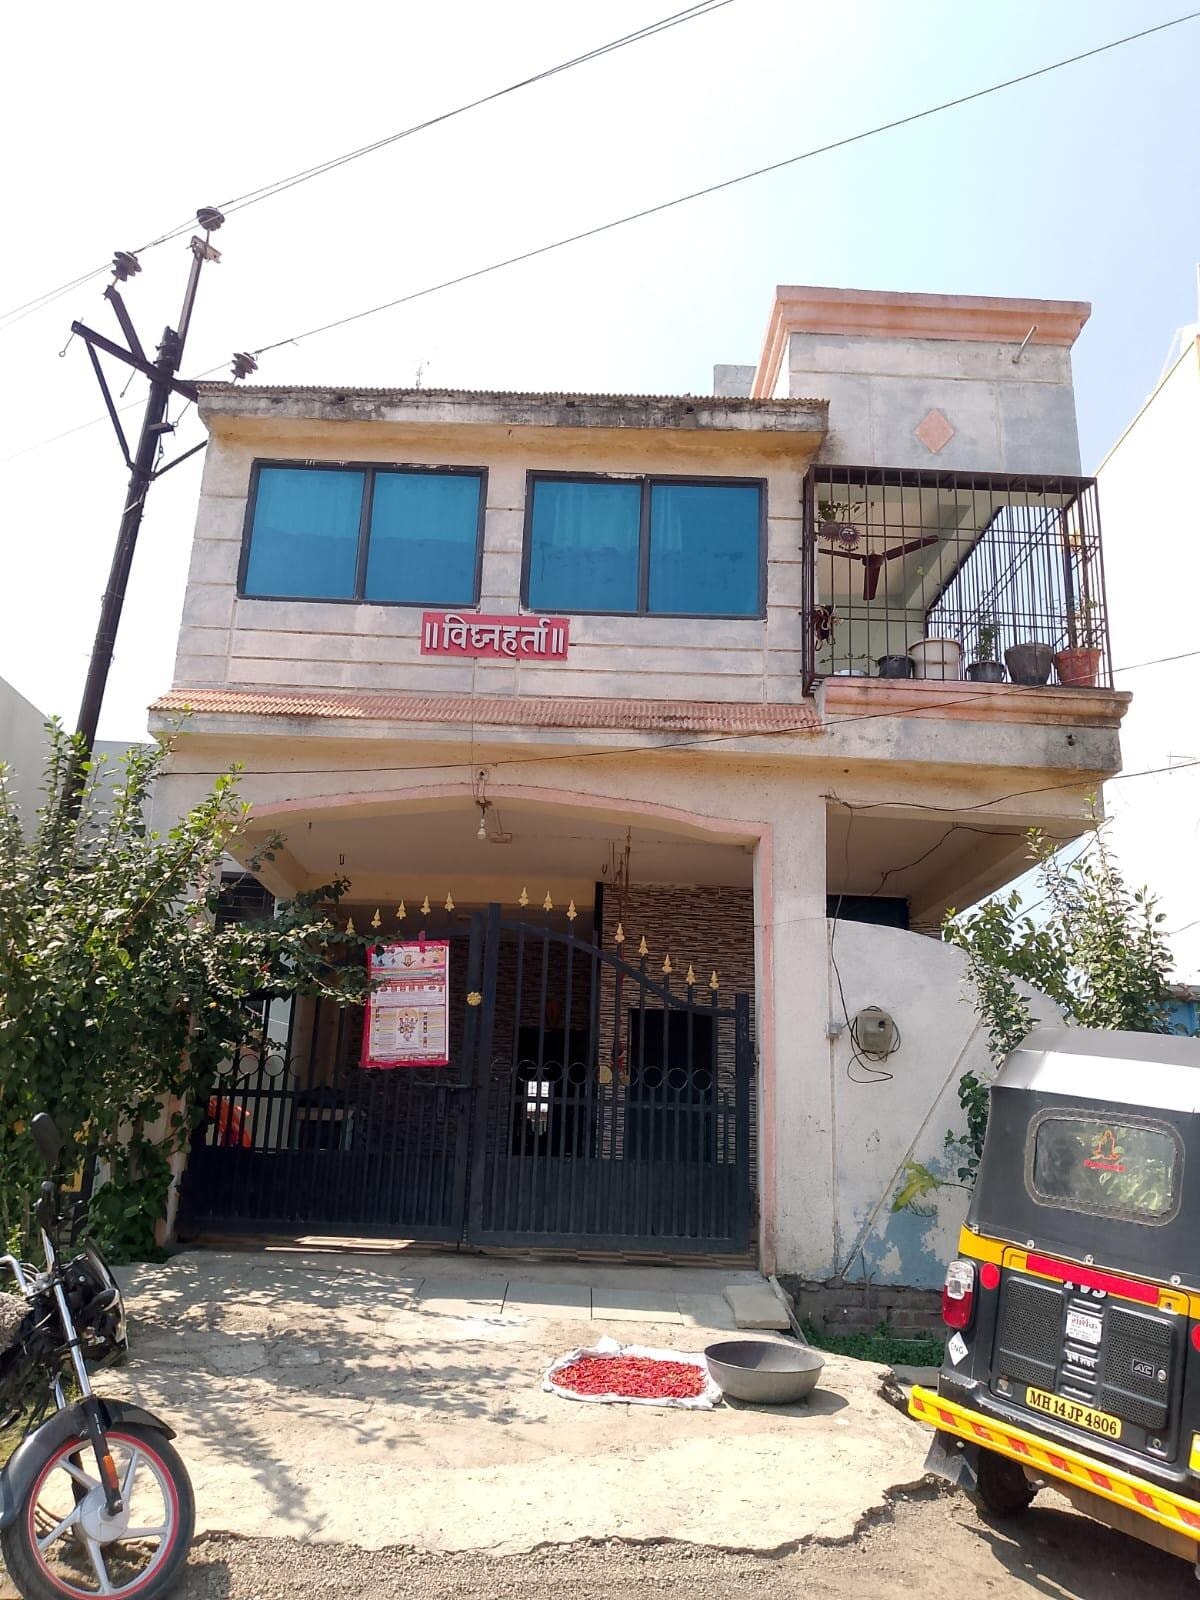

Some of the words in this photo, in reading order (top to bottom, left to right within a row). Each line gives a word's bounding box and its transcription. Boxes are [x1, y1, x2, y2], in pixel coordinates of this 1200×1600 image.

[950, 1341, 964, 1355] CNG
[1029, 1390, 1051, 1411] MH
[1054, 1400, 1066, 1417] 14
[1067, 1406, 1083, 1422] JP
[1084, 1412, 1117, 1435] 4806
